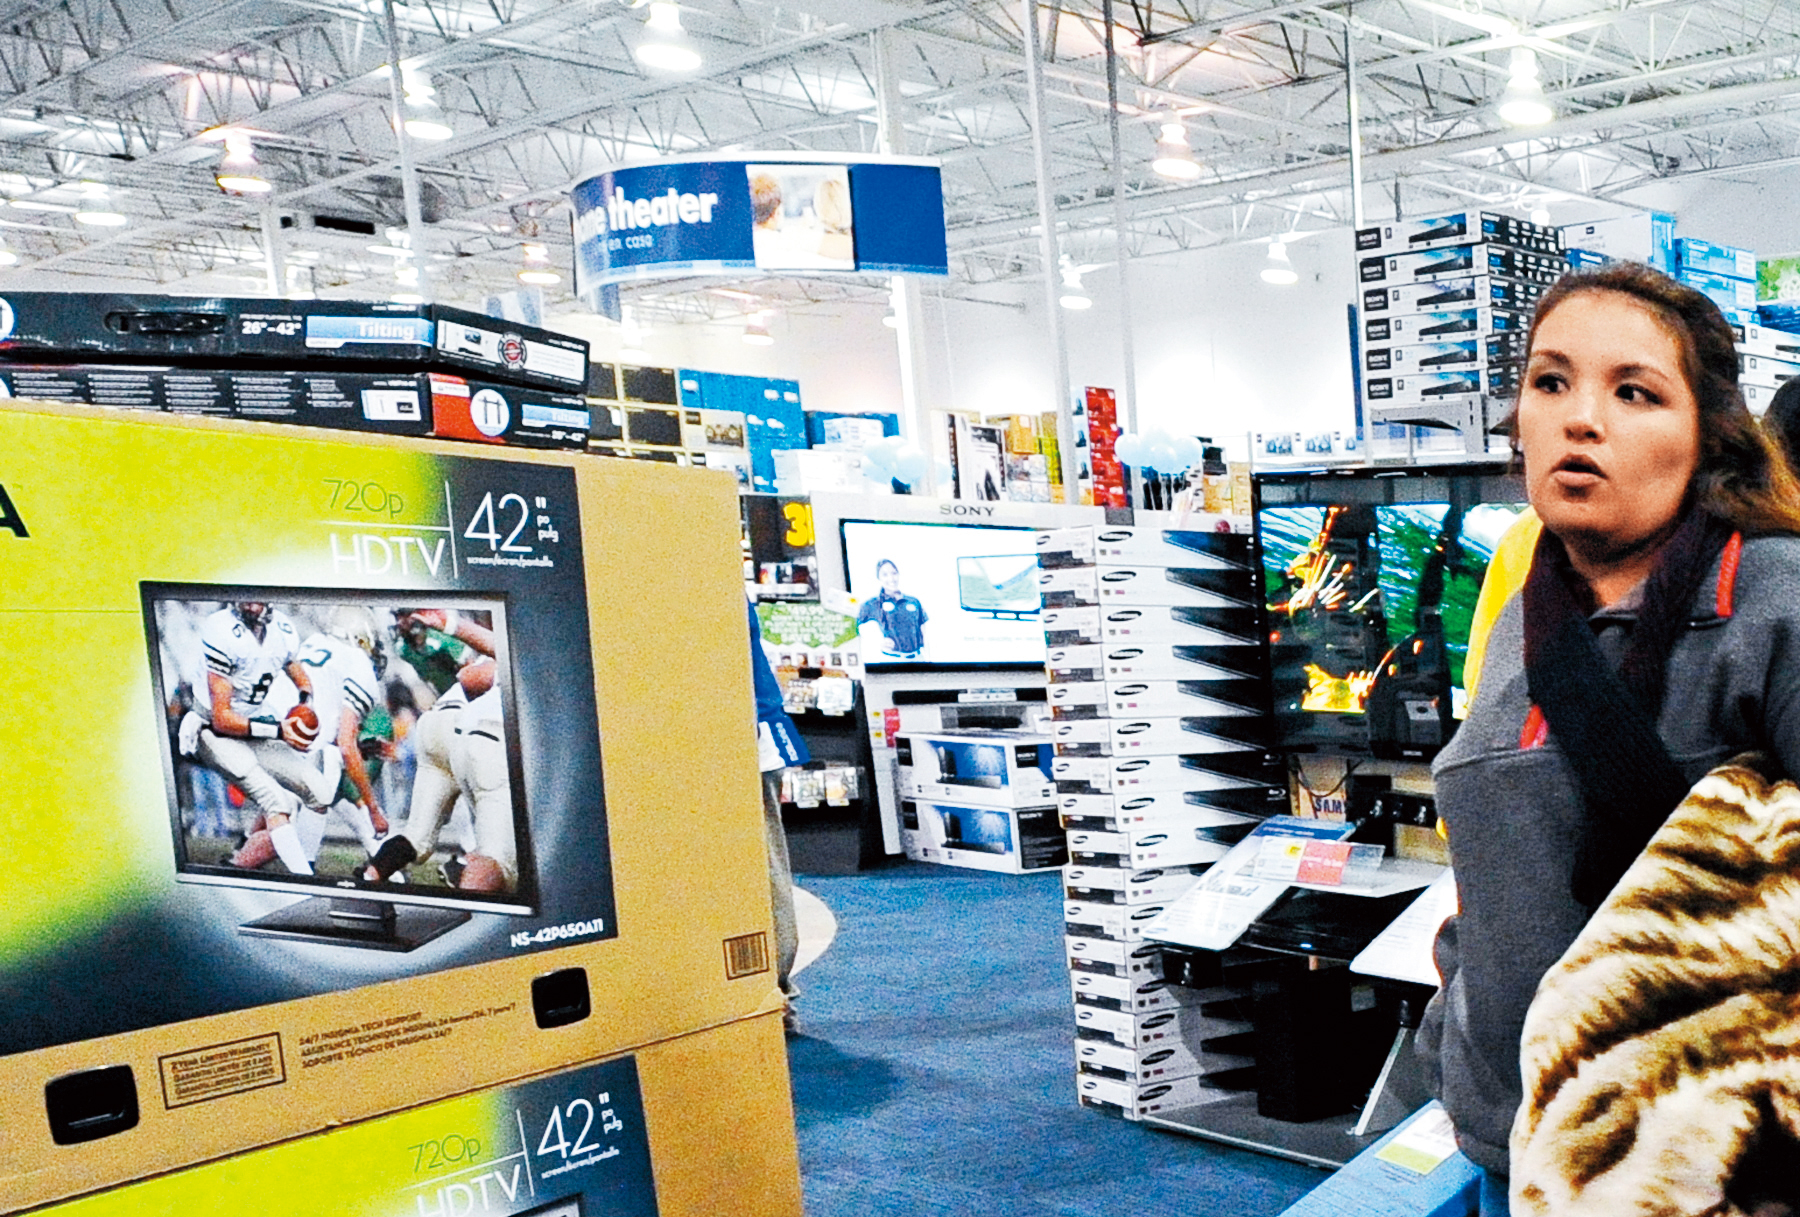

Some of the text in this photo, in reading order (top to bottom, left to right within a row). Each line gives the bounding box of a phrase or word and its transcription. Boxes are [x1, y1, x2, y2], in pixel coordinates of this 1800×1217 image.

[608, 186, 718, 231] theater
[625, 234, 653, 249] casa
[357, 320, 415, 340] Tilting
[323, 479, 403, 518] 720p
[939, 504, 996, 518] SONY
[330, 532, 446, 577] HDTV
[384, 1012, 422, 1026] SUPPORT
[302, 1052, 343, 1068] SOPORTE
[407, 1134, 481, 1173] 720p
